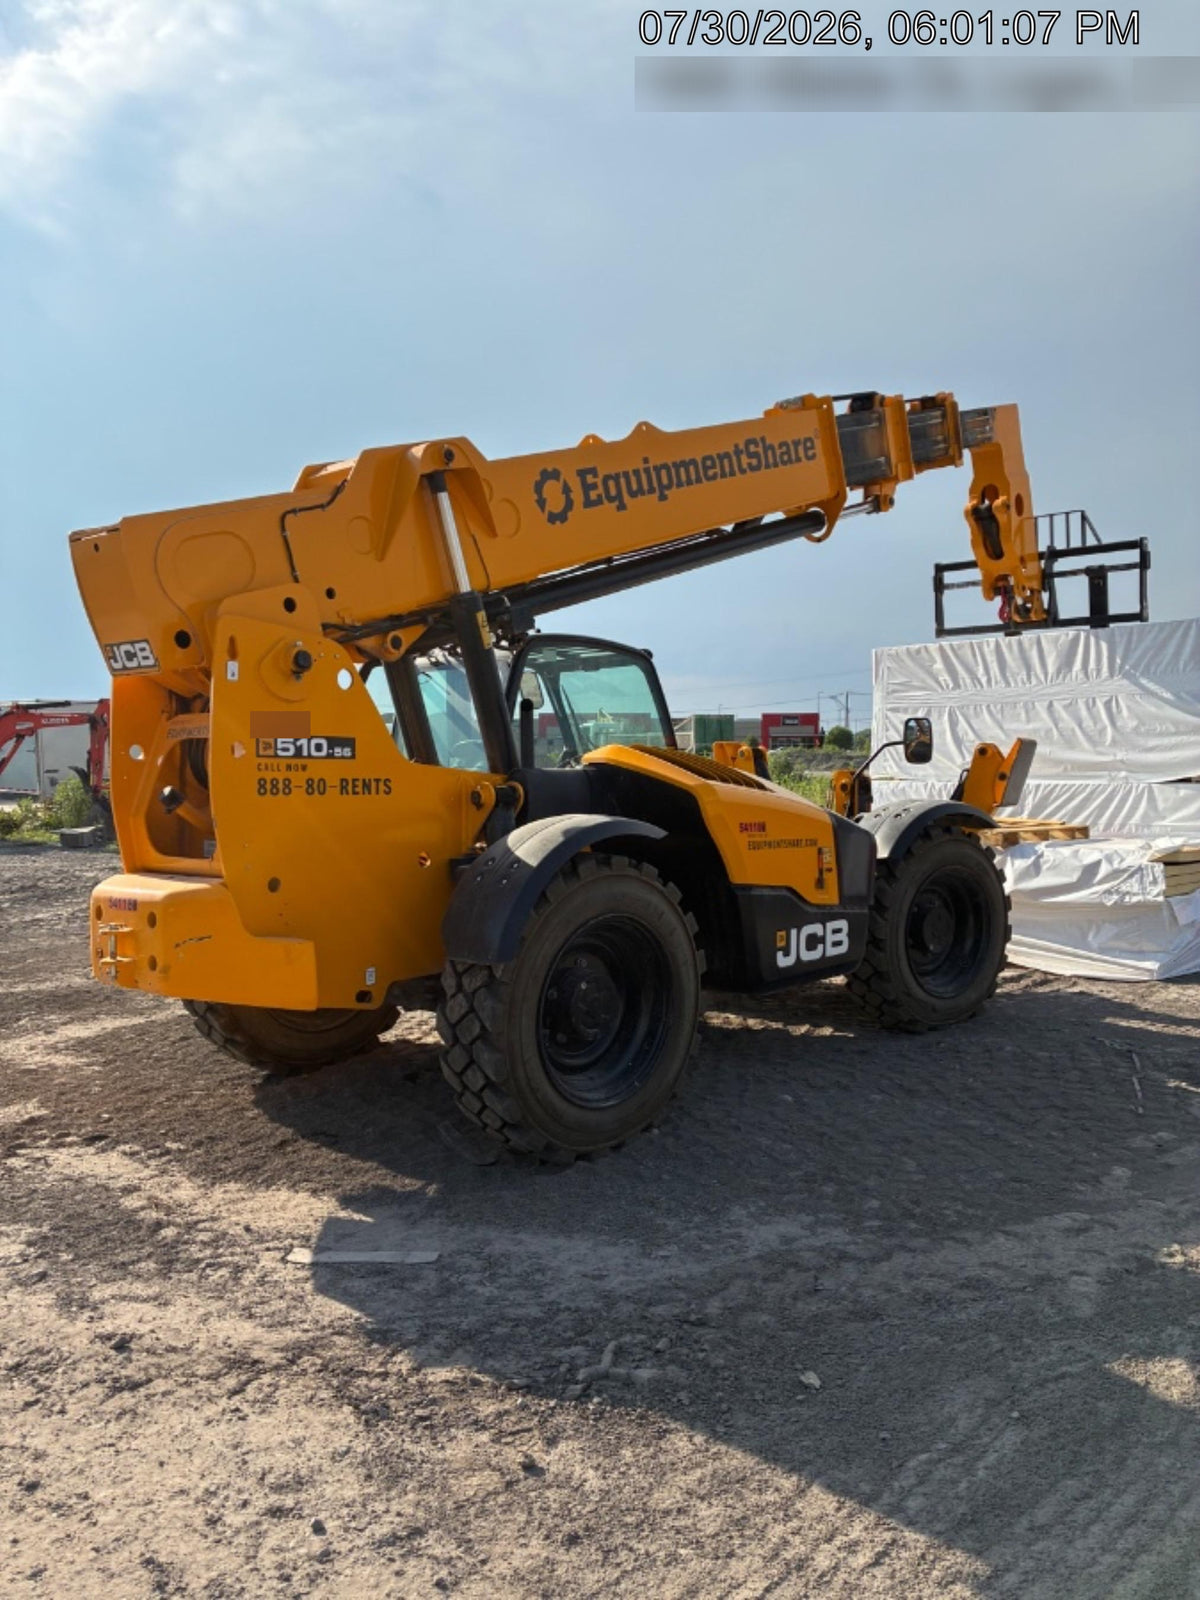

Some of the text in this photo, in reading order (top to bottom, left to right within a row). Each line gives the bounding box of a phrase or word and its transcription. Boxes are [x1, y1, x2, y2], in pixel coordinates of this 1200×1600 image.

[576, 436, 817, 512] EquipmentShare
[110, 641, 156, 669] JCB
[256, 763, 308, 772] CALL NOW
[257, 778, 392, 796] 888-80-RENTS
[776, 918, 849, 968] JCB
